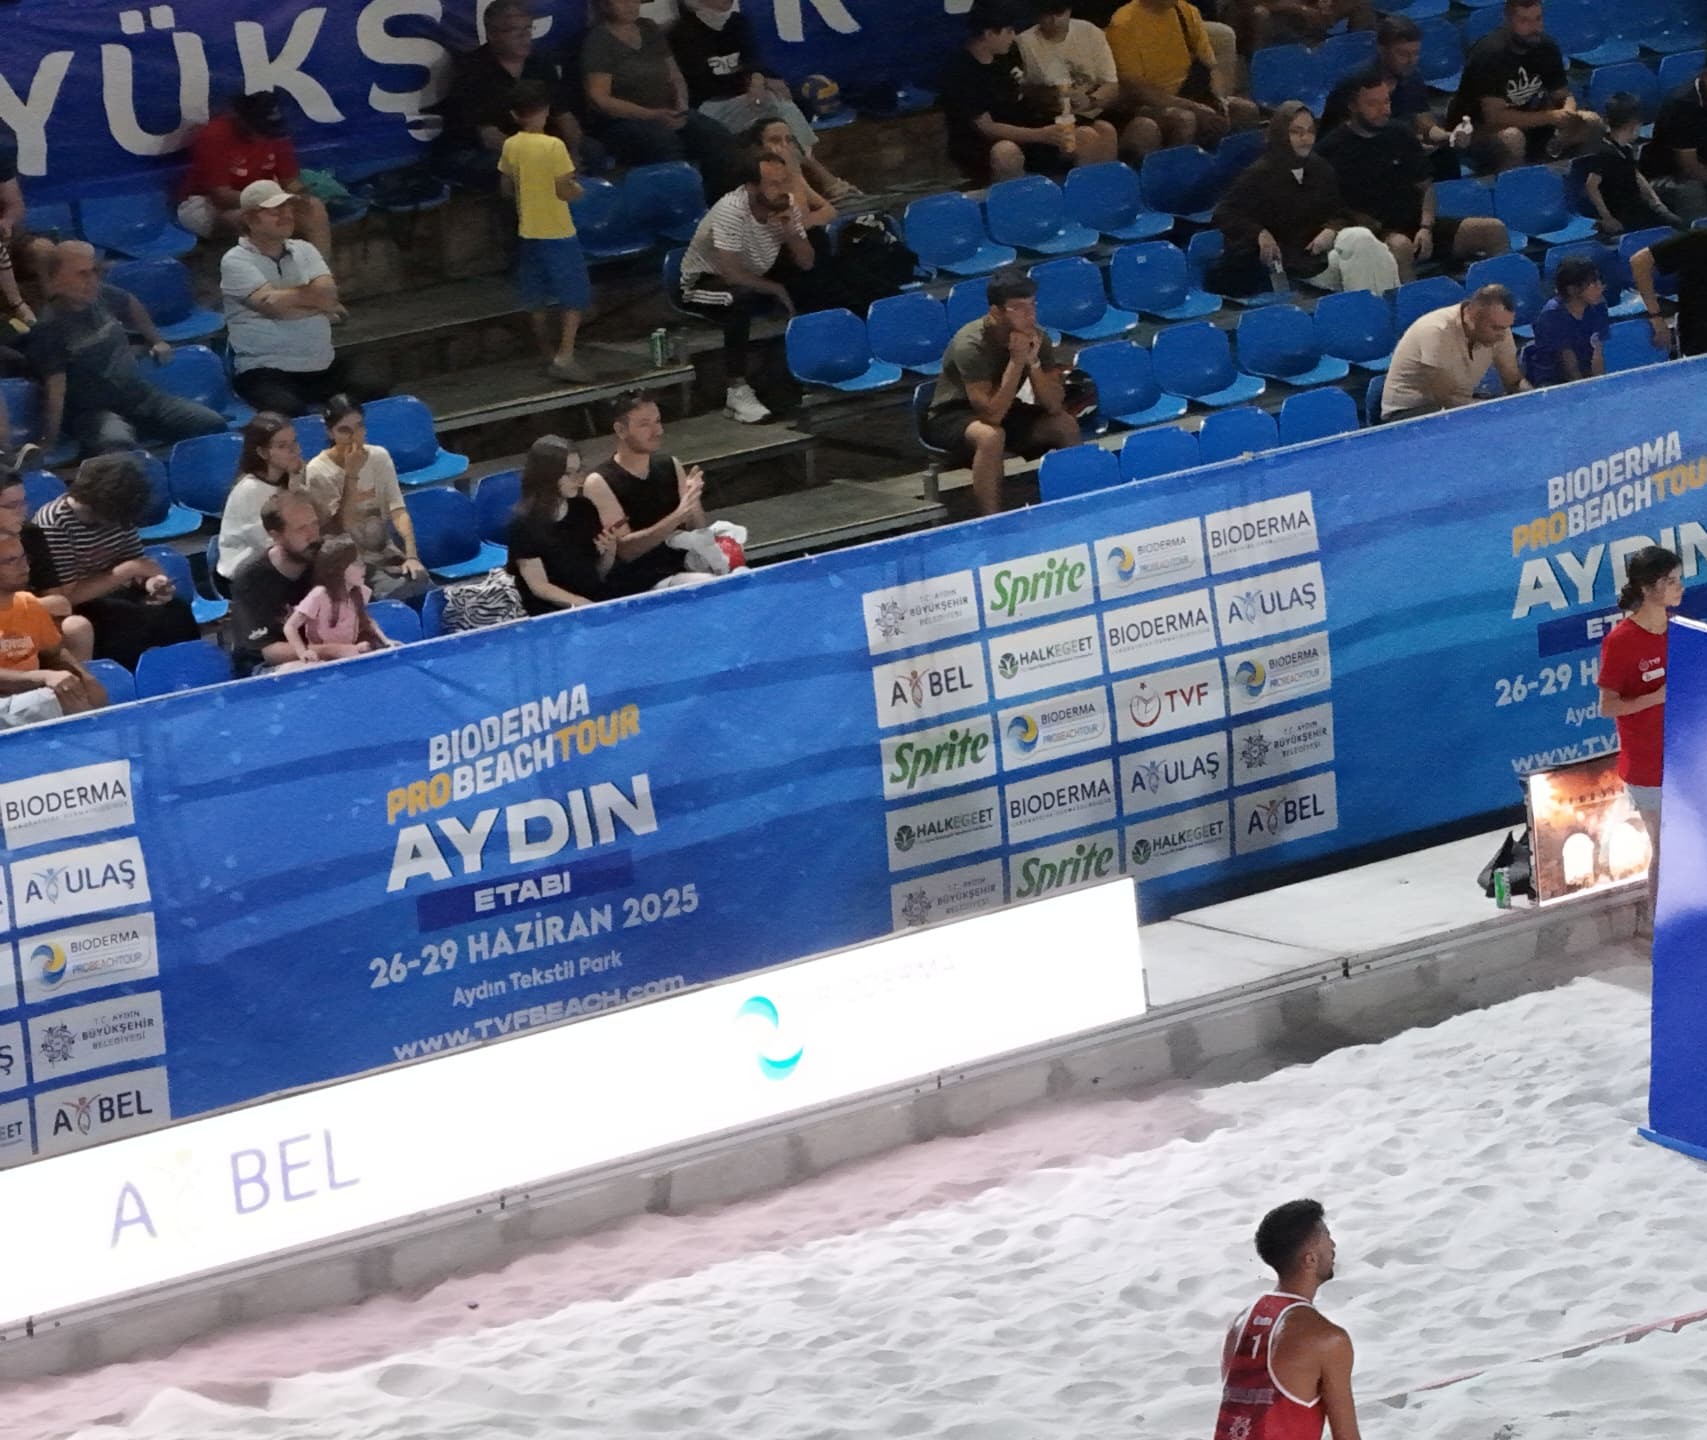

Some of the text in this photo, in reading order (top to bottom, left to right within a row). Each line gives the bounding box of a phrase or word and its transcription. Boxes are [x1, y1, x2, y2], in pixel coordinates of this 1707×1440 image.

[1548, 431, 1682, 509] BIODERMA
[1137, 536, 1186, 555] BIODERMA
[1211, 510, 1310, 548] BIODERMA
[990, 557, 1085, 617] Sprite
[1109, 608, 1208, 646] BIODERMA
[1019, 636, 1092, 666] HALKEGEET
[1269, 648, 1318, 669] BIODERMA
[1165, 682, 1208, 712] TVF
[1495, 664, 1572, 707] 26-29
[429, 683, 590, 771] BIODERMA
[1041, 703, 1095, 725] BIODERMA
[890, 728, 988, 789] Sprite
[6, 780, 126, 821] BIODERMA
[1011, 779, 1111, 819] BIODERMA
[387, 773, 658, 892] AYDIN
[917, 808, 994, 837] HALKEGEET
[1153, 821, 1224, 851] HALKEGEET
[1016, 842, 1113, 898] Sprite
[474, 872, 571, 912] ETABI
[70, 930, 139, 953] BIODERMA
[370, 883, 698, 989] 26-29 HAZİRAN 2025
[453, 950, 622, 1008] Aydın Tekstil Park
[1252, 1333, 1262, 1359] 1
